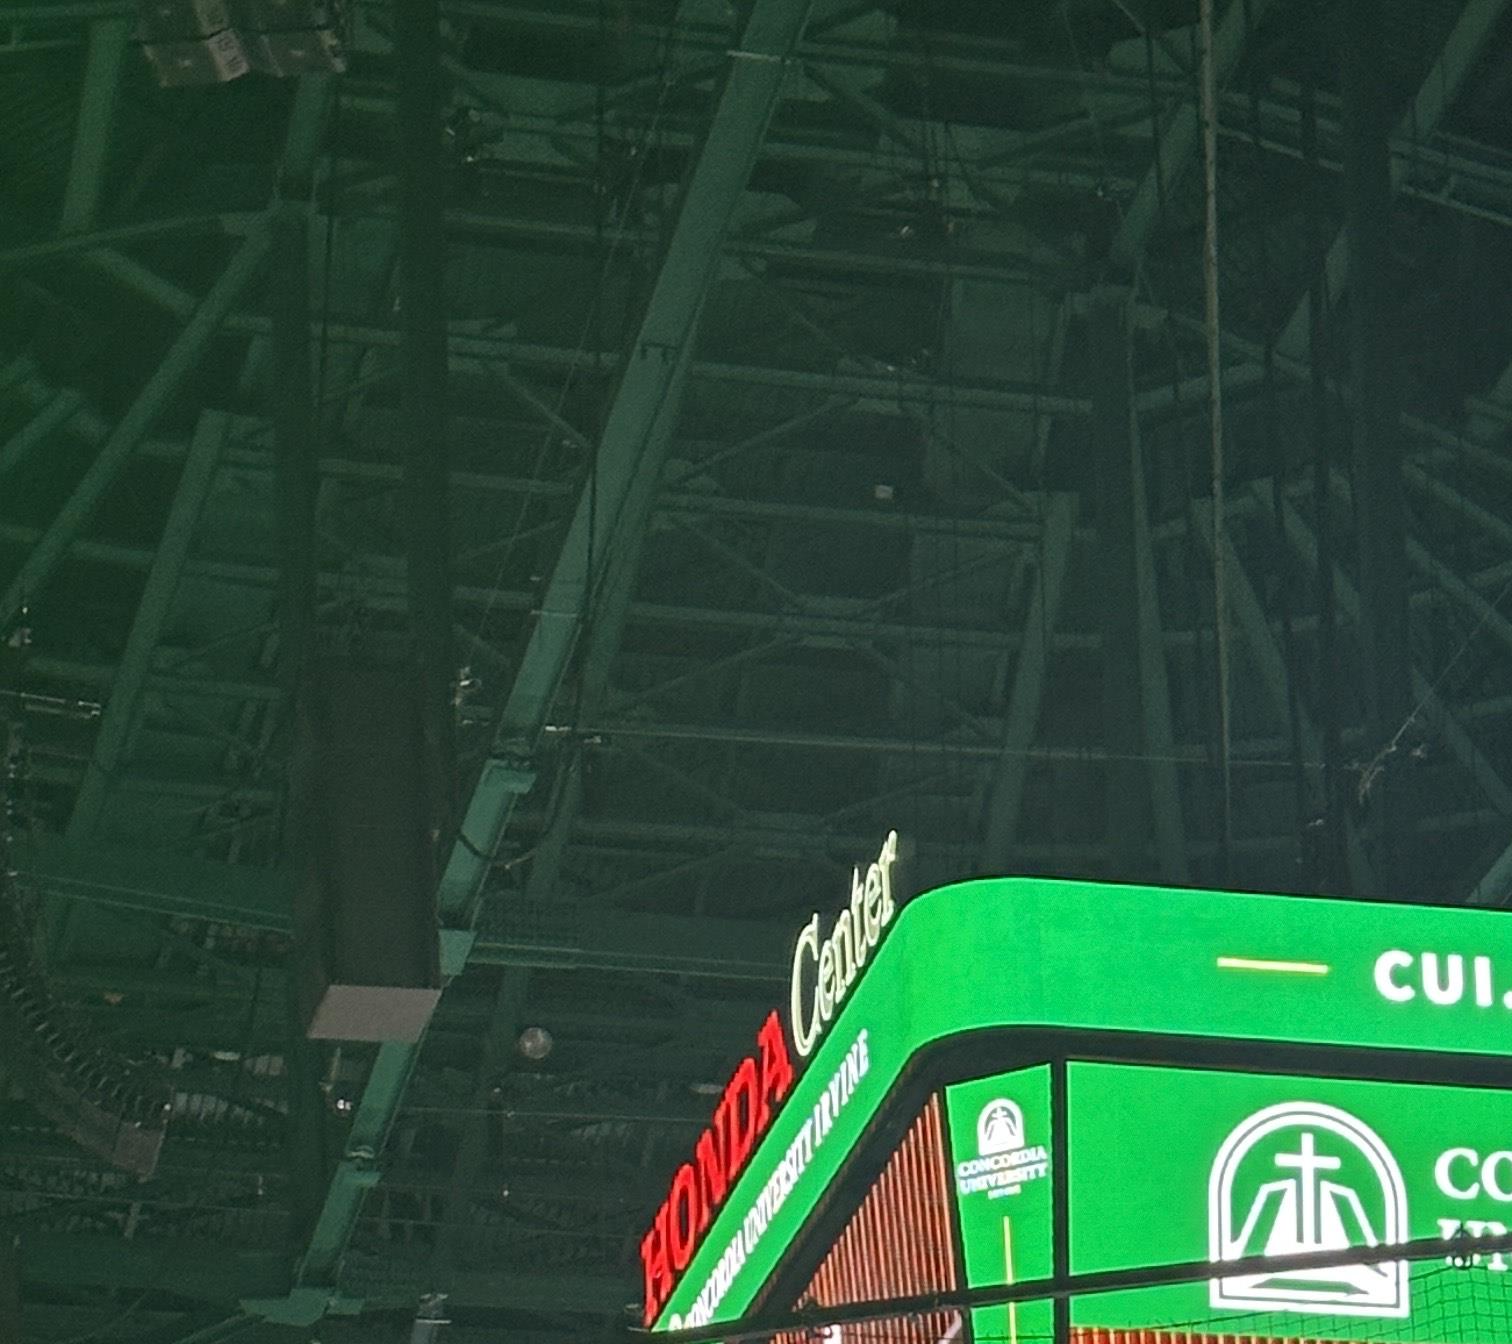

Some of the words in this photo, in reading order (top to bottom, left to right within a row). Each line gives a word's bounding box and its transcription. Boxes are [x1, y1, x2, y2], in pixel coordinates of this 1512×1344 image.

[640, 1010, 792, 1328] HONDA
[791, 829, 898, 1057] Center
[811, 1028, 869, 1148] IRVINE
